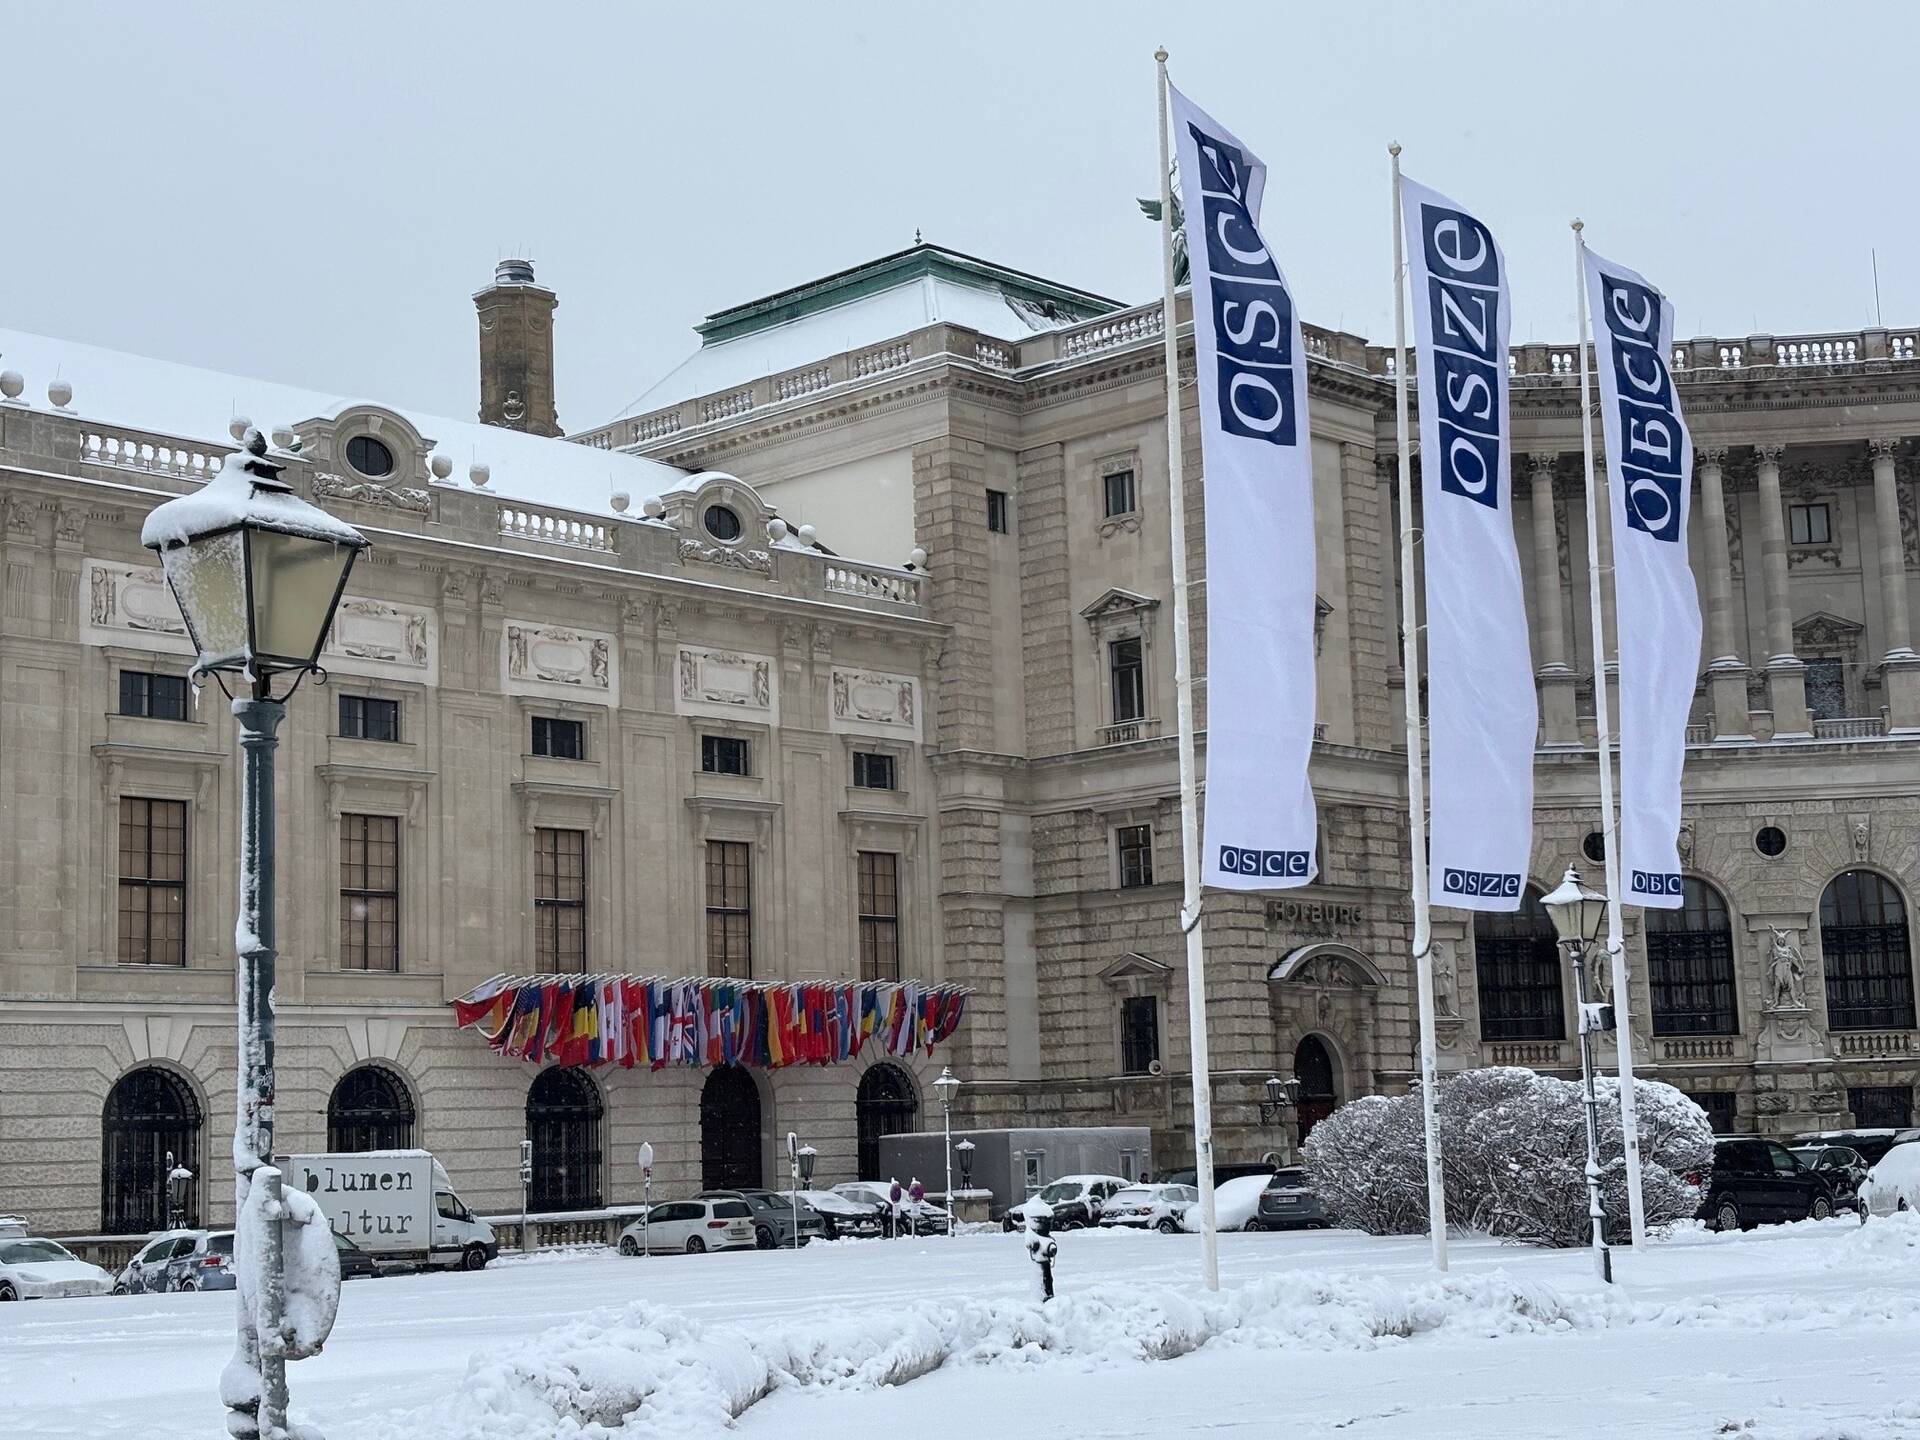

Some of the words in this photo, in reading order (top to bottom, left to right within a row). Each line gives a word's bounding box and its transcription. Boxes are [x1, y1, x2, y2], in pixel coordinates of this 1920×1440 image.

[1433, 218, 1492, 495] osze
[1222, 849, 1306, 873] osce
[1446, 872, 1518, 894] osze
[303, 1167, 413, 1192] blumen
[328, 1209, 413, 1235] ltur
